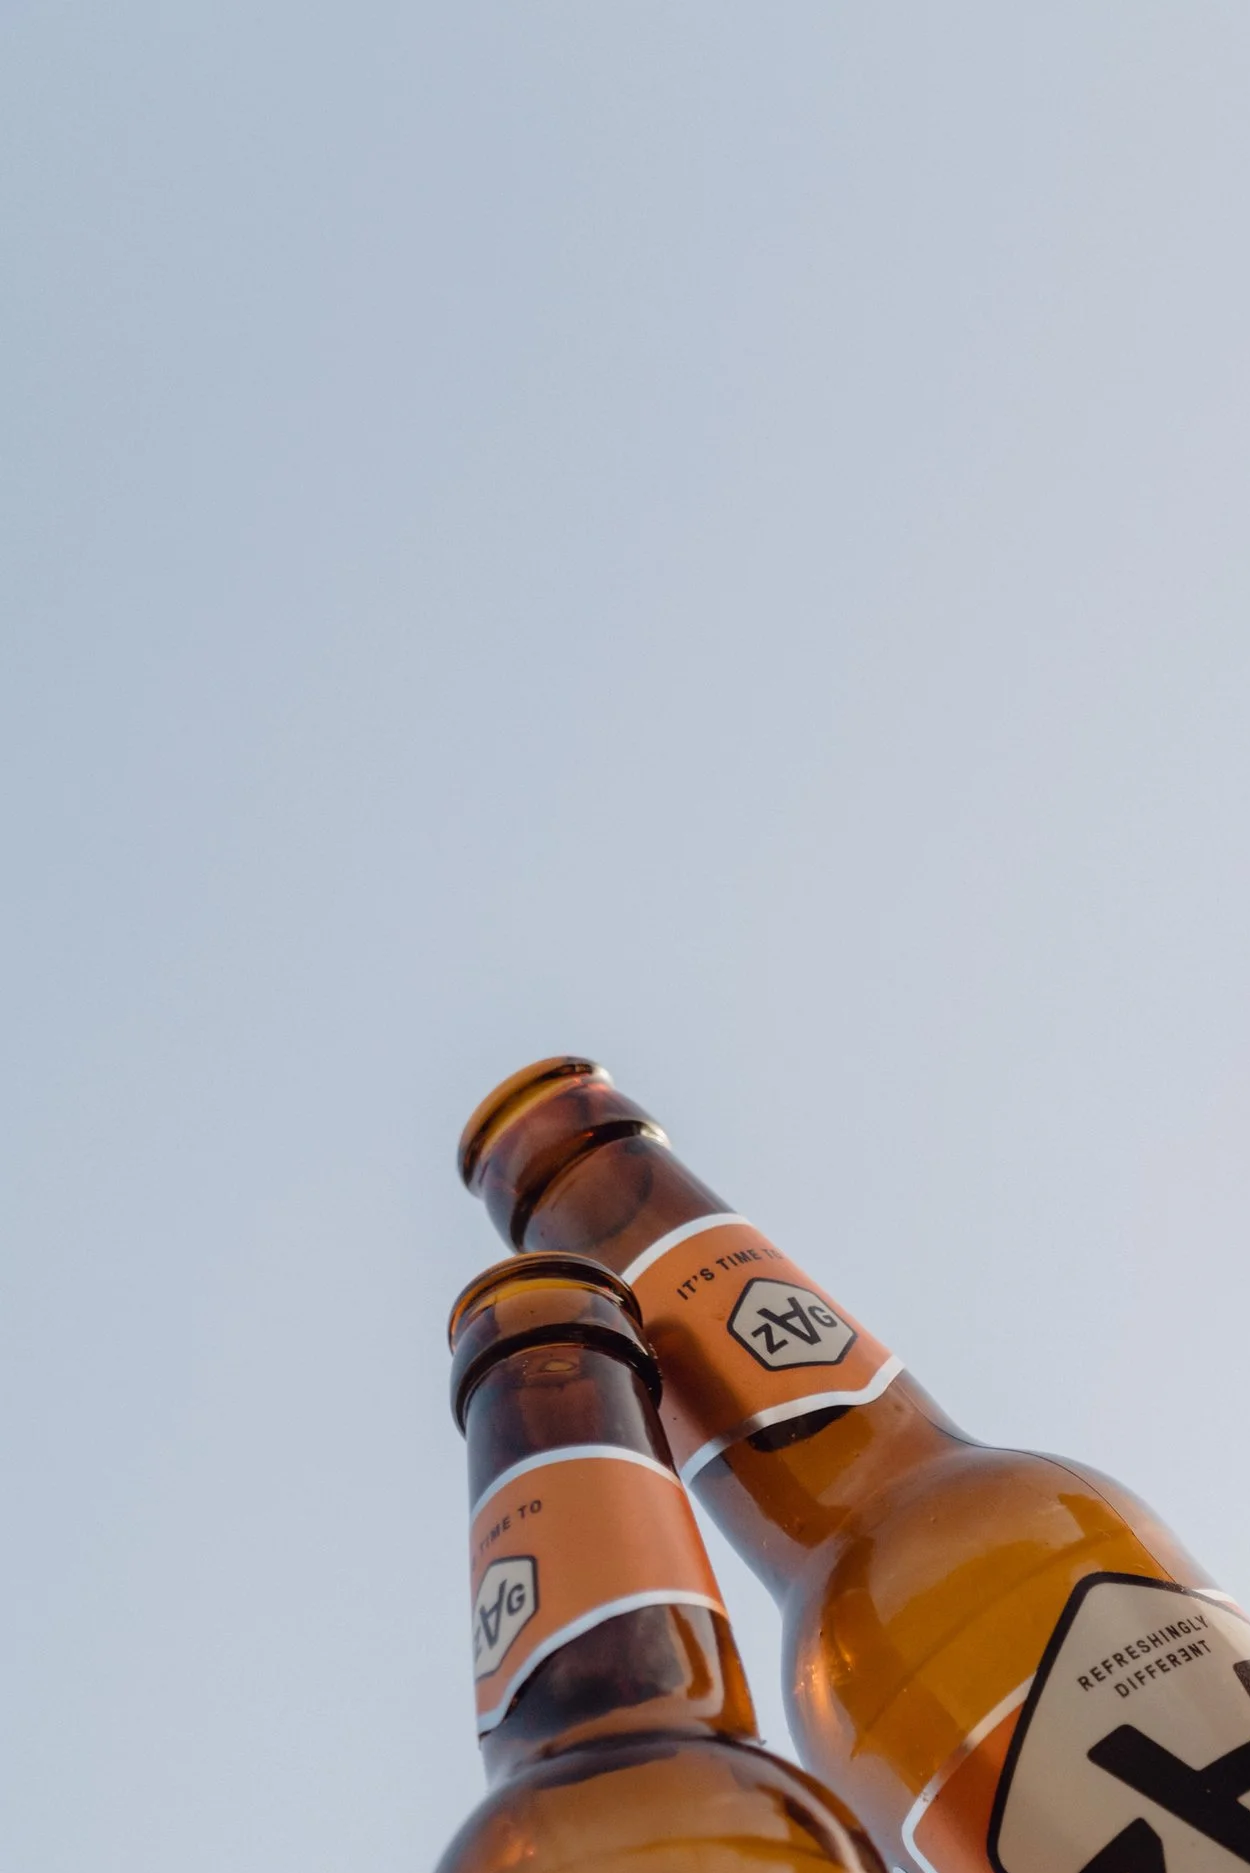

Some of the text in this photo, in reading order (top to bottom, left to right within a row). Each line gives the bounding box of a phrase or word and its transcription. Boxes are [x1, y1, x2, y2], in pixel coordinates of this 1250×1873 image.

[676, 1267, 716, 1300] IT'S
[716, 1249, 763, 1271] TIME
[517, 1499, 543, 1519] TO
[1076, 1615, 1209, 1692] REFRESHINGLY
